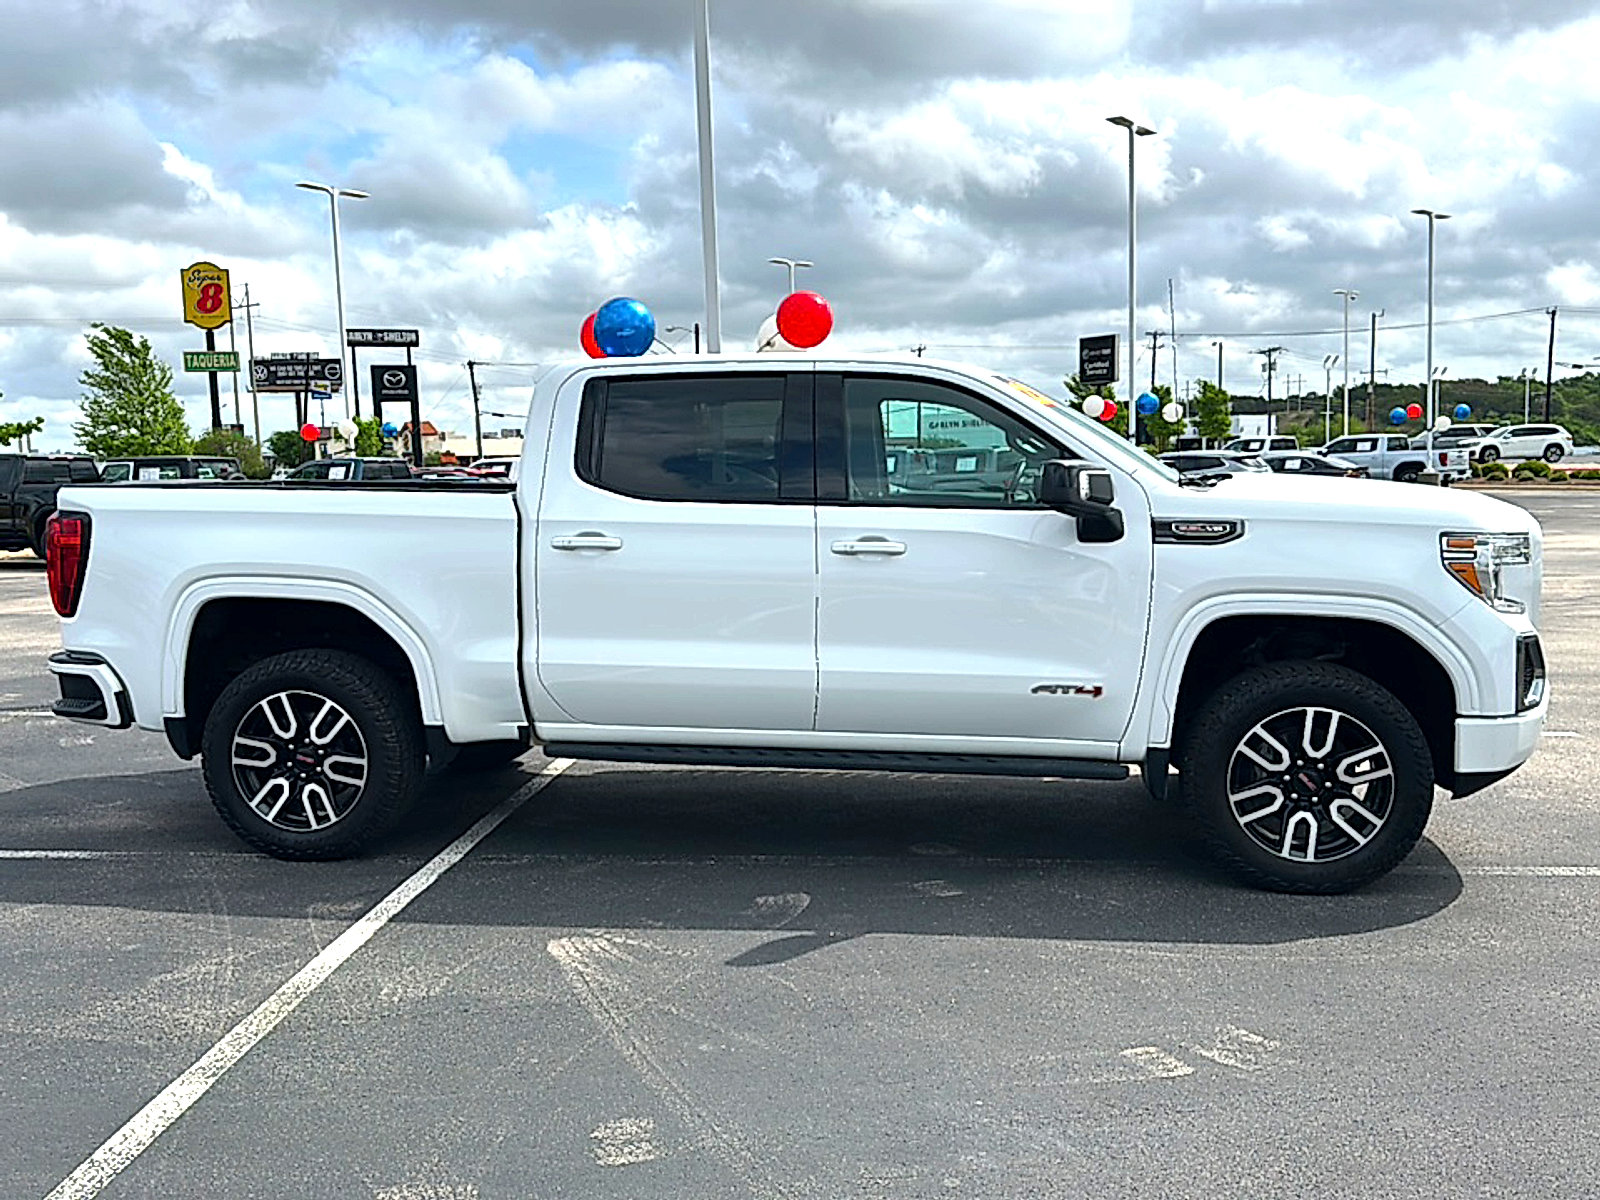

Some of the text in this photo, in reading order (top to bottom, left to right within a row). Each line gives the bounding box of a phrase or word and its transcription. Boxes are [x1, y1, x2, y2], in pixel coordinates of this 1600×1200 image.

[187, 269, 221, 288] Super
[196, 283, 224, 314] 8
[185, 354, 236, 369] TAQUERIA
